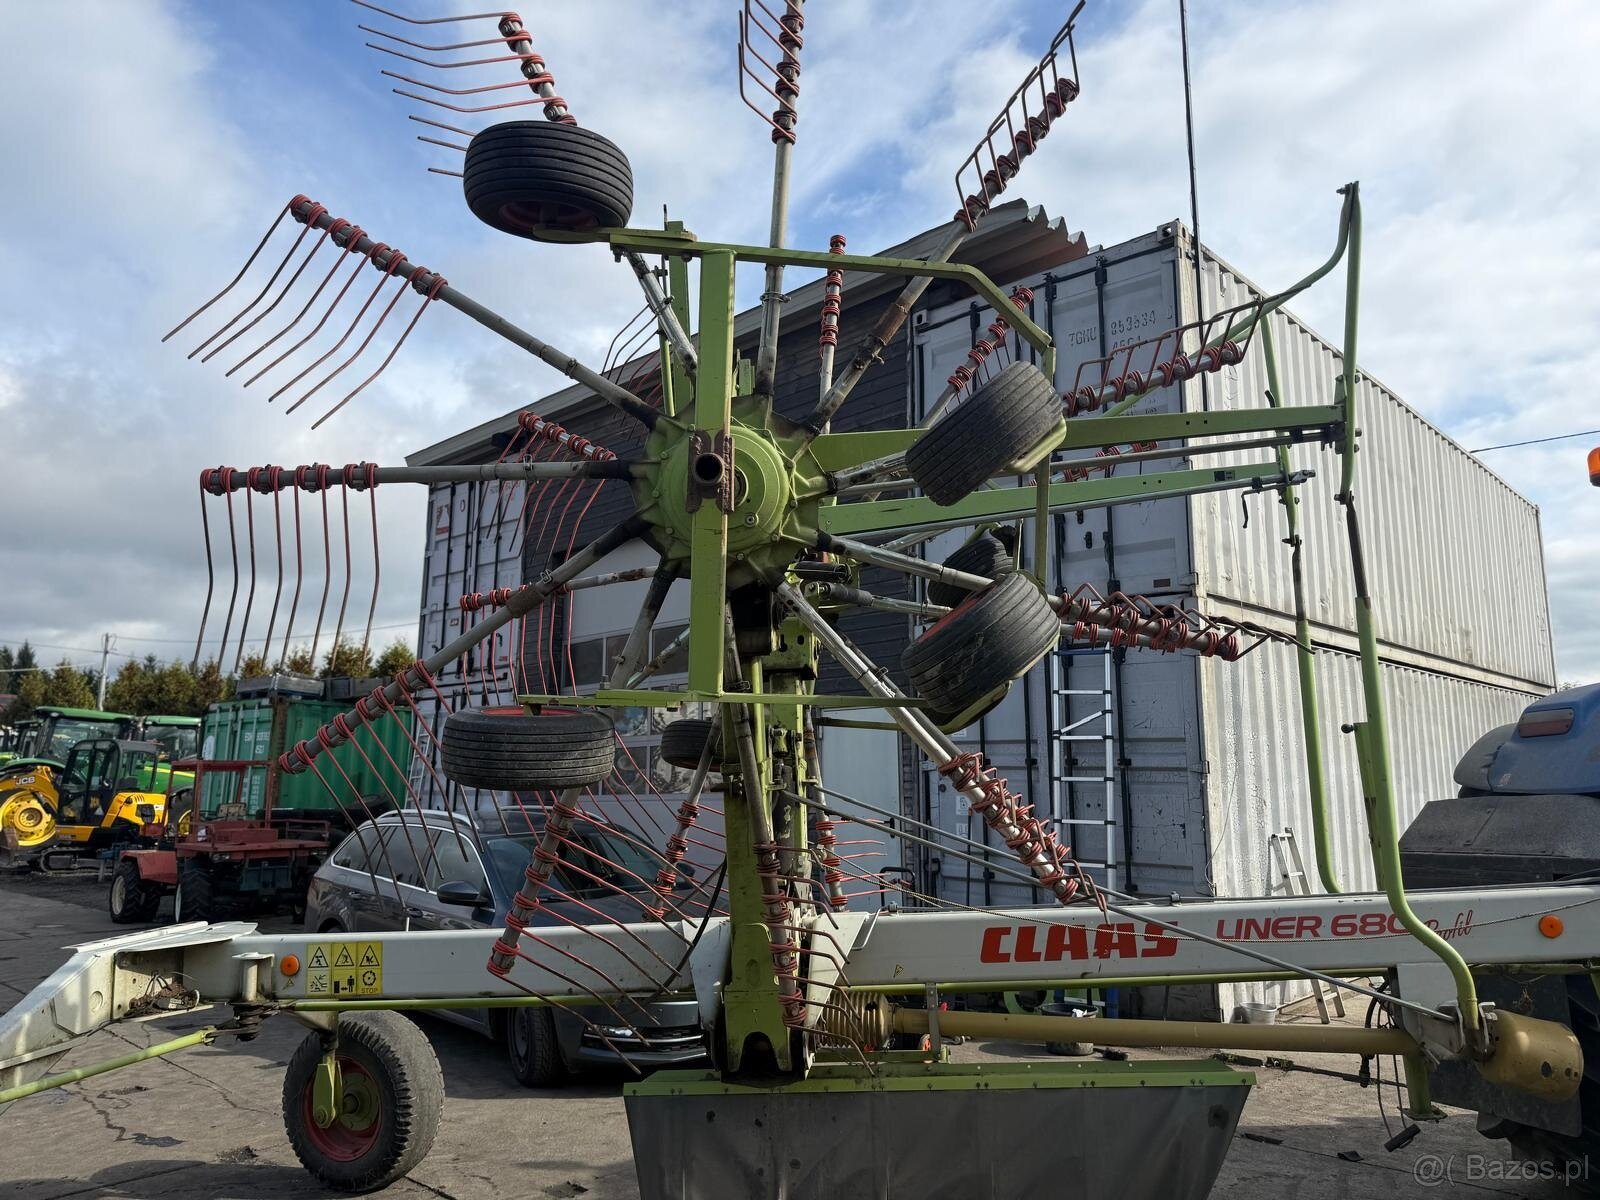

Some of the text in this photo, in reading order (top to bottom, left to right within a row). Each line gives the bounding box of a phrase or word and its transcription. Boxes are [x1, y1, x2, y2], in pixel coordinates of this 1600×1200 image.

[16, 776, 36, 785] JCB
[1216, 915, 1323, 940] LINER
[981, 921, 1179, 963] CLAAS
